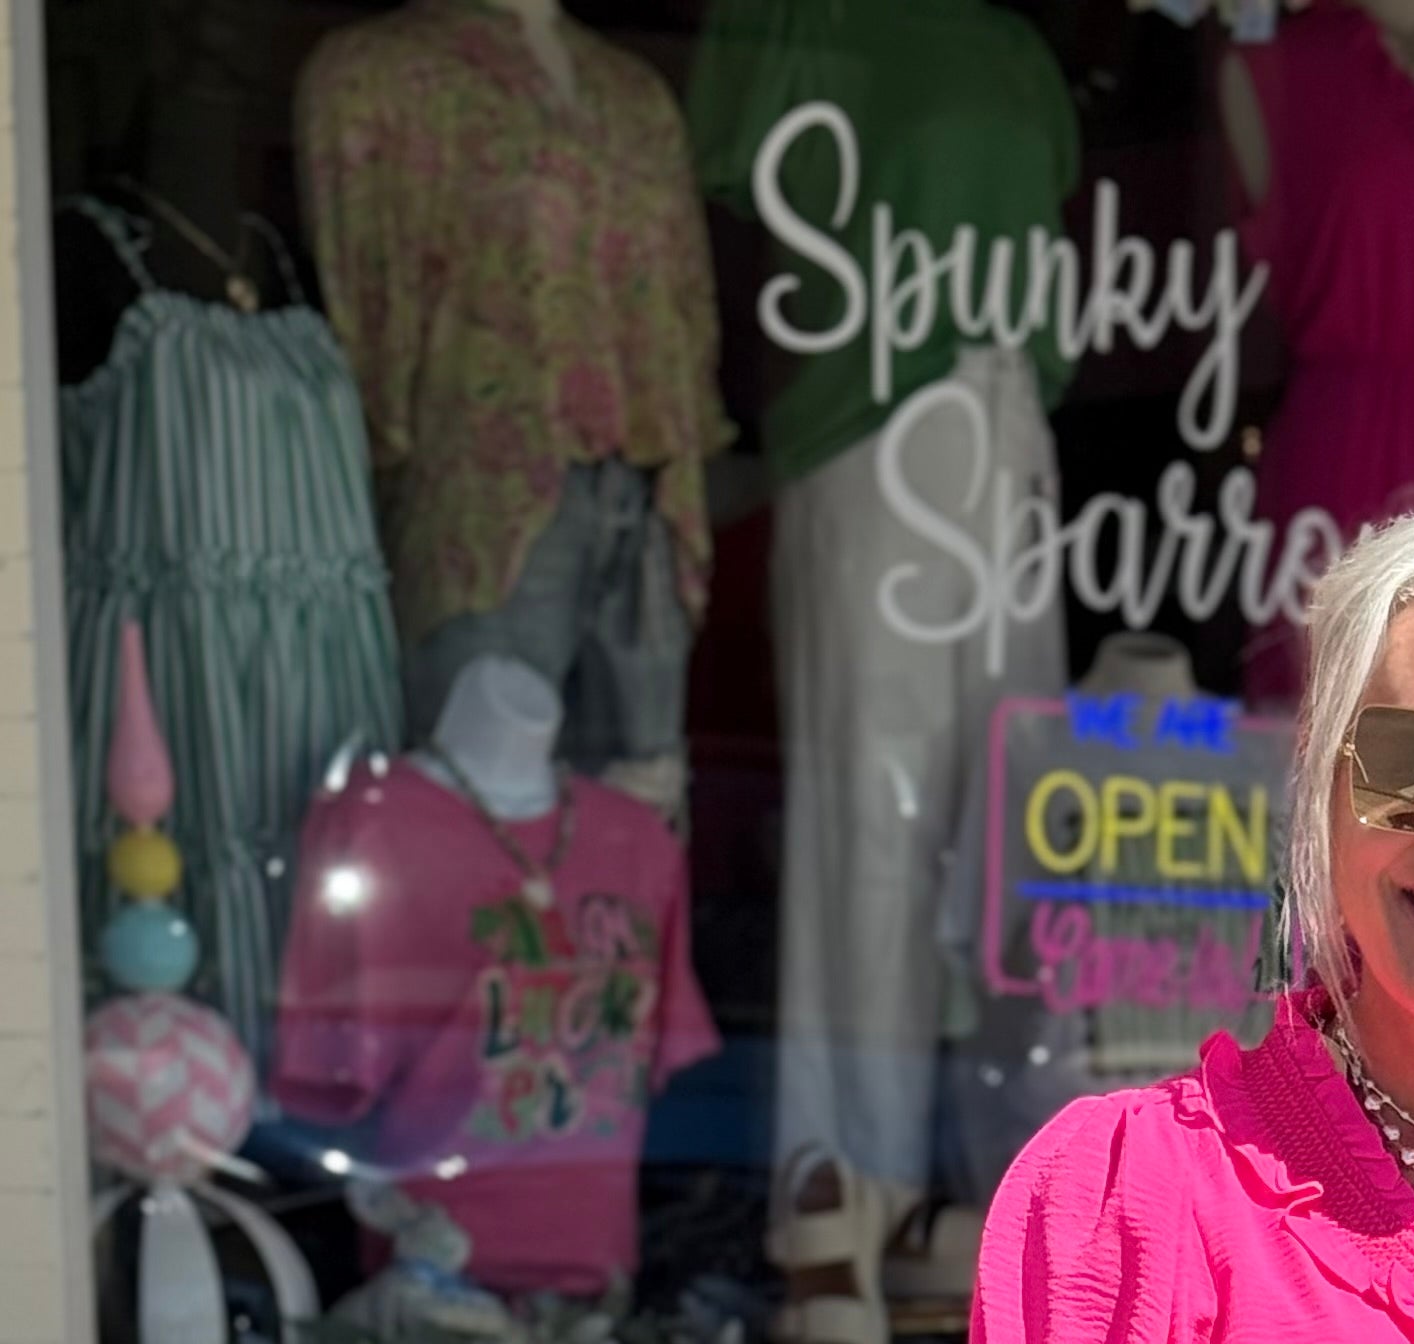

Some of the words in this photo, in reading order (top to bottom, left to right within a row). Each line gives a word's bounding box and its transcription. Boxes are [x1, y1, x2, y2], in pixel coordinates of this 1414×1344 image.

[752, 101, 1271, 452] Spunky
[874, 379, 1355, 678] Sparro
[1025, 769, 1268, 883] OPEN
